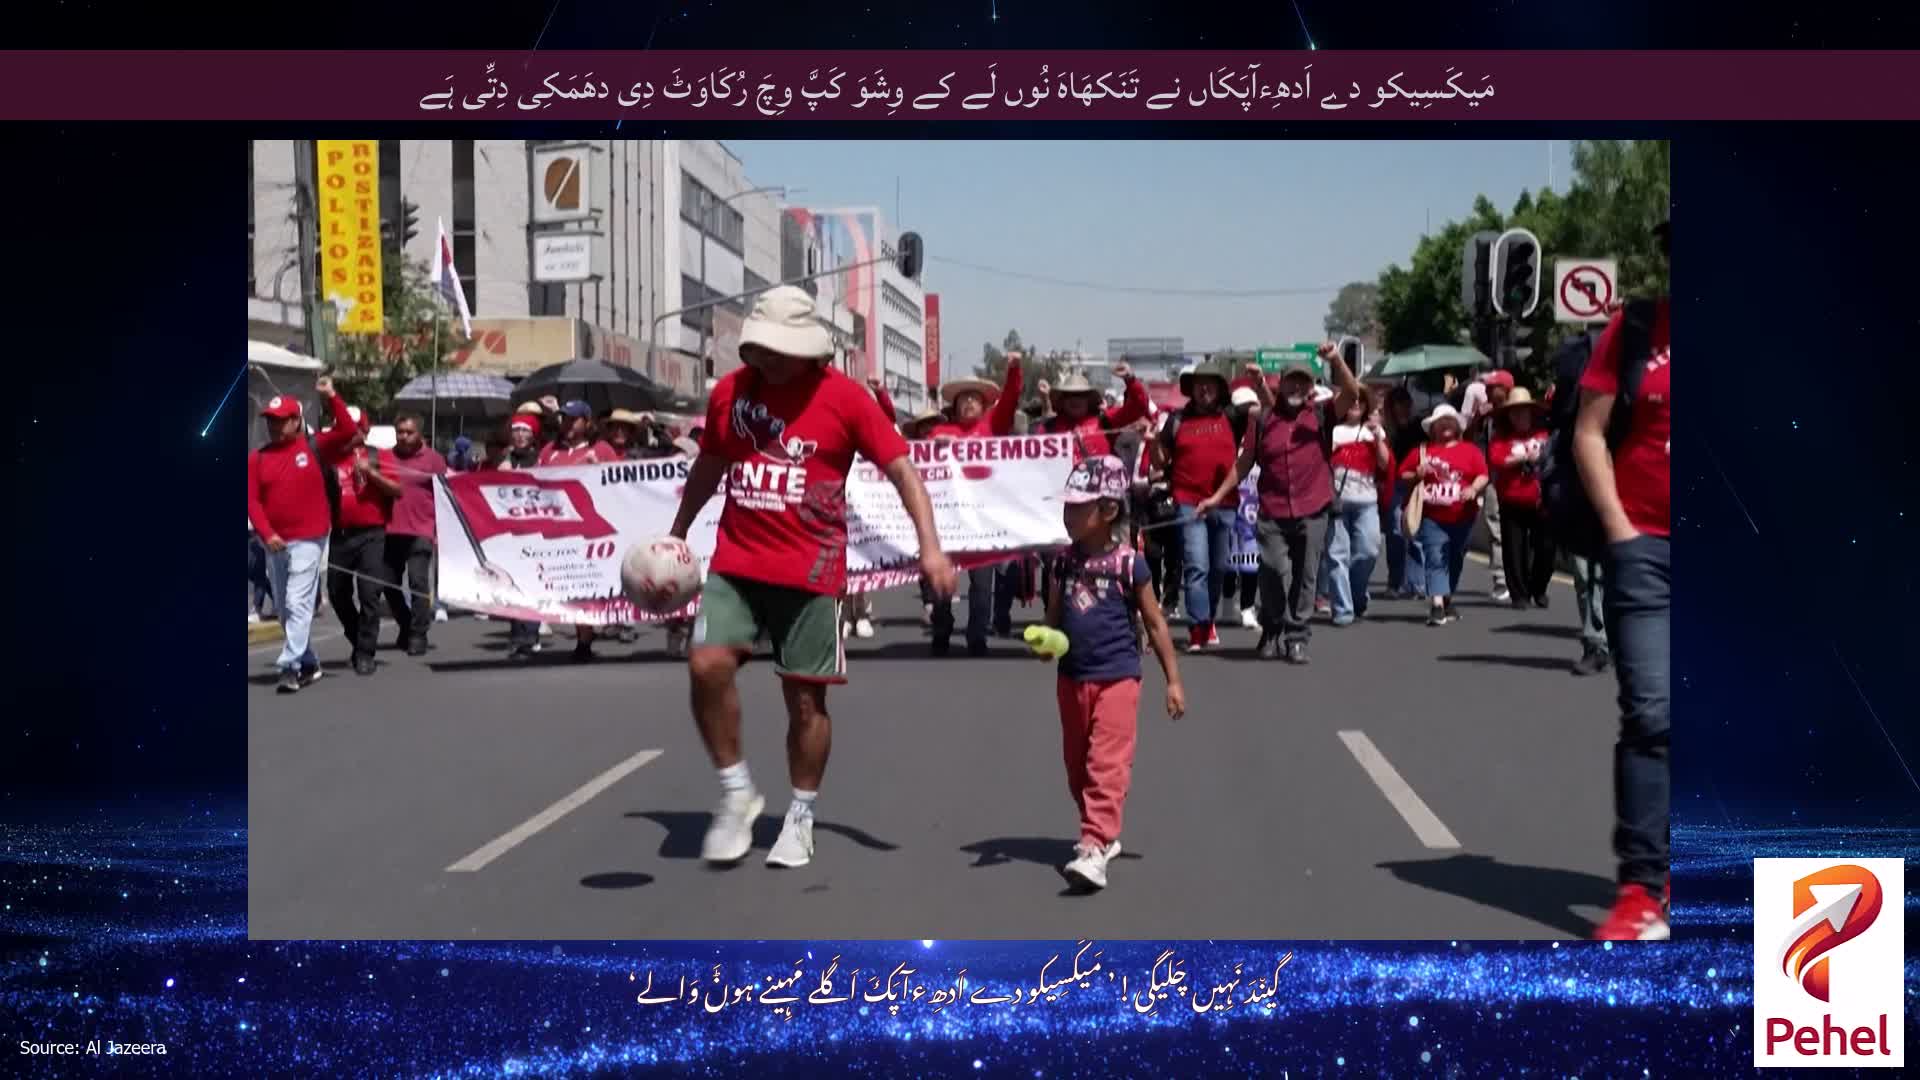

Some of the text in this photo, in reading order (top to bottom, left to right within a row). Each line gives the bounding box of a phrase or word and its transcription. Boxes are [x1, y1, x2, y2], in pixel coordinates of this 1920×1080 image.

[326, 150, 350, 285] POLLOS
[352, 142, 377, 323] ROSTIZADOS
[601, 437, 1069, 486] ¡UNIDOS NCEREMOS!
[730, 461, 807, 495] CNTE
[586, 541, 616, 560] 10
